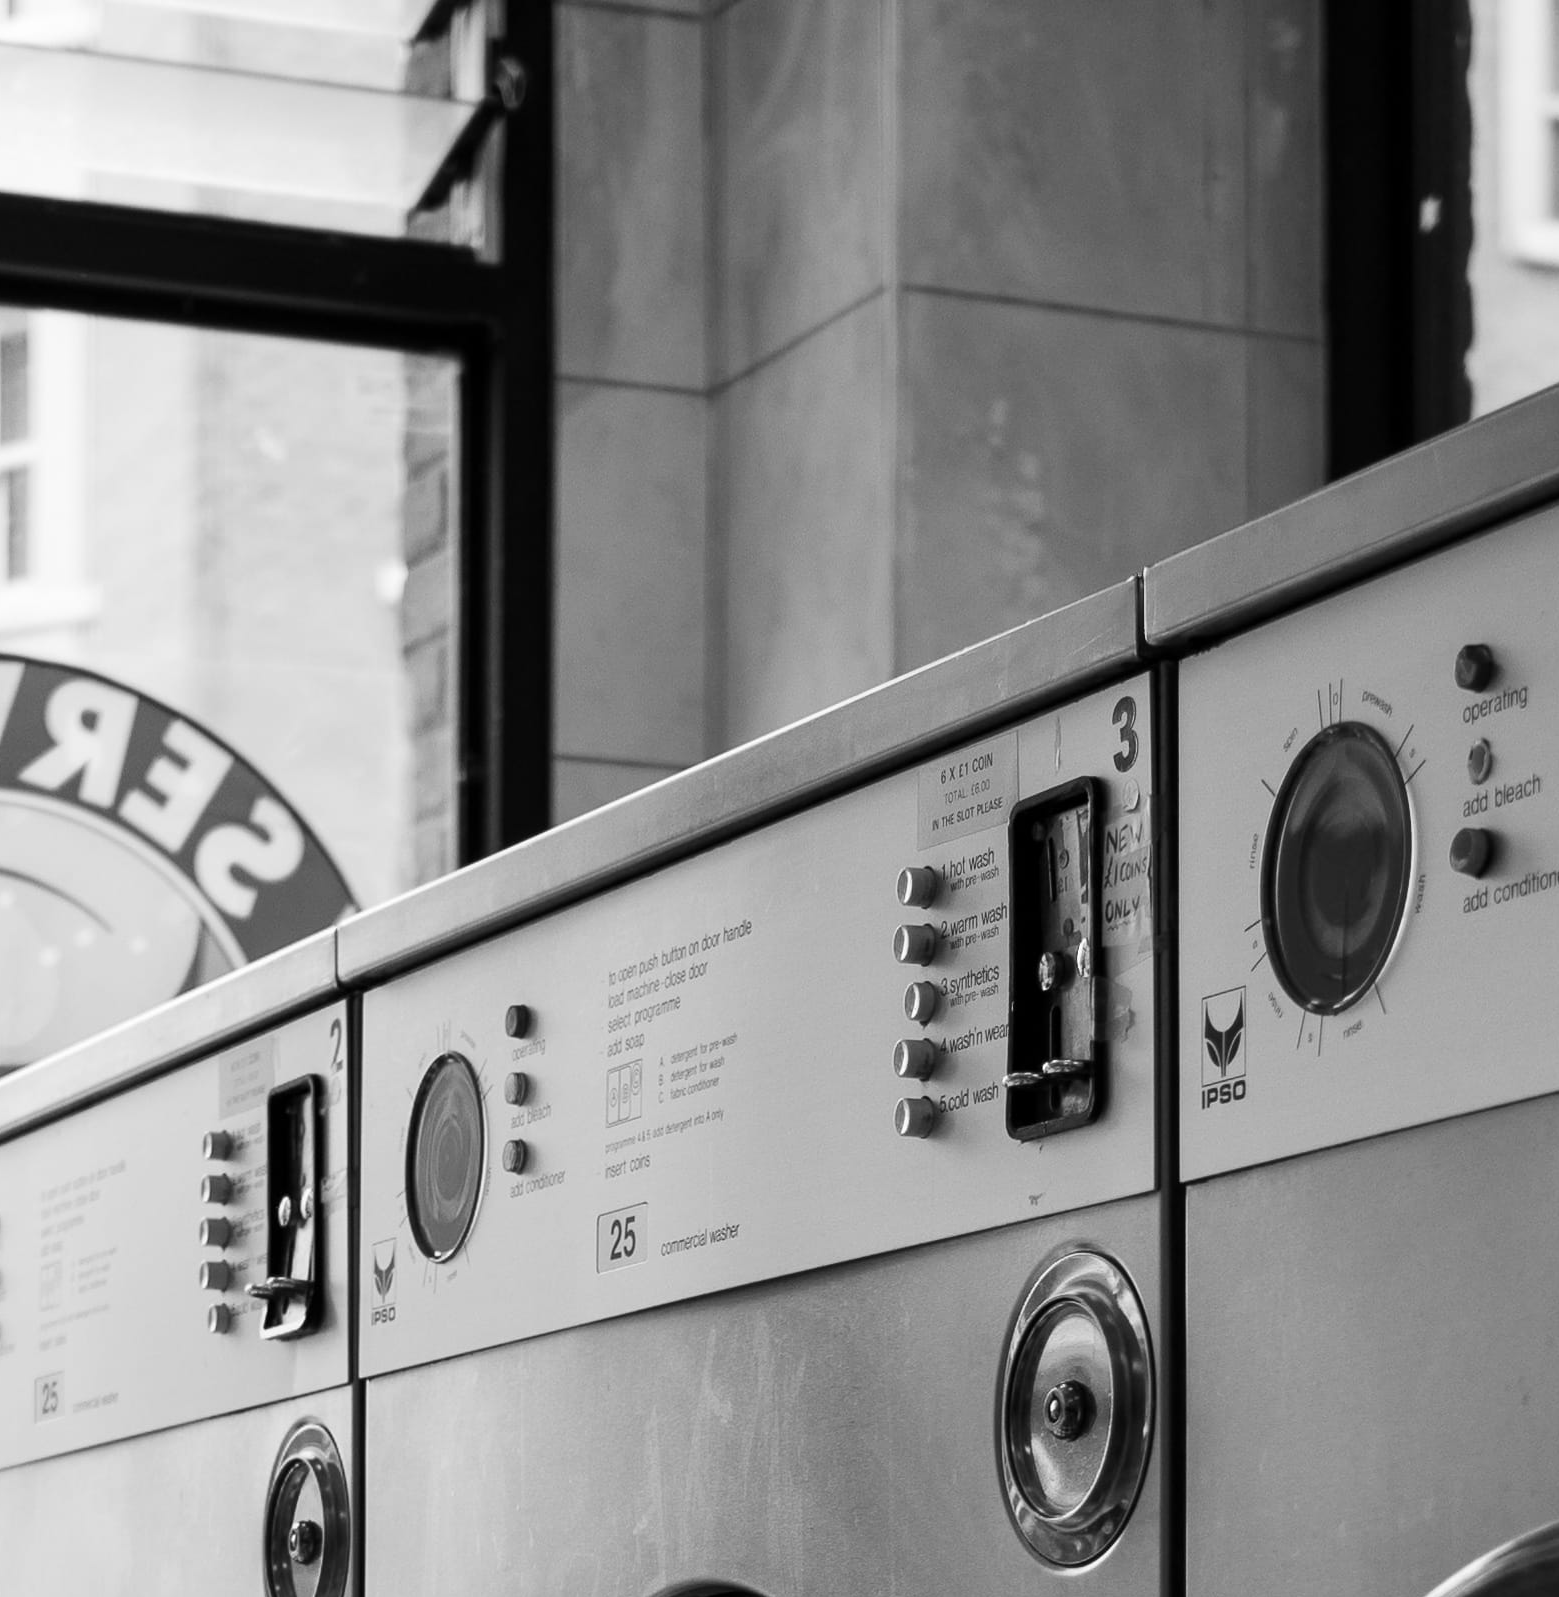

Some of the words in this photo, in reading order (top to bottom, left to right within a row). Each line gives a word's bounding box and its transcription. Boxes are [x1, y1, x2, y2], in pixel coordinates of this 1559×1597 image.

[1462, 685, 1529, 725] operating
[1112, 695, 1140, 773] 3
[940, 769, 947, 785] 6
[949, 765, 956, 782] X
[971, 751, 994, 773] COIN
[1462, 791, 1489, 818] add
[1494, 773, 1542, 808] bleach
[932, 818, 940, 831] IN
[941, 812, 955, 828] THE
[956, 806, 975, 823] SLOT
[976, 796, 1003, 817] PLEASE
[1105, 823, 1143, 855] NEW
[968, 847, 995, 872] wash
[950, 878, 965, 892] with
[1462, 888, 1488, 914] add
[981, 902, 1008, 926] wash
[1105, 895, 1141, 924] ONLY
[608, 971, 617, 987] to
[618, 964, 638, 984] open
[639, 954, 659, 977] push
[661, 944, 687, 967] button
[688, 940, 700, 956] on
[701, 932, 721, 952] door
[723, 919, 753, 944] handle
[608, 991, 625, 1009] load
[688, 961, 709, 981] door
[608, 1011, 632, 1034] select
[634, 996, 681, 1026] programme
[329, 1018, 344, 1073] 2
[607, 1038, 623, 1058] add
[624, 1033, 646, 1052] soap
[985, 1022, 1009, 1043] wear
[973, 1081, 999, 1105] wash
[1201, 1079, 1247, 1111] IPSO
[629, 1153, 651, 1173] coins
[609, 1215, 636, 1261] 25
[660, 1227, 708, 1257] commercial
[709, 1222, 741, 1245] washer
[371, 1306, 397, 1327] IPSO
[41, 1380, 60, 1415] 25
